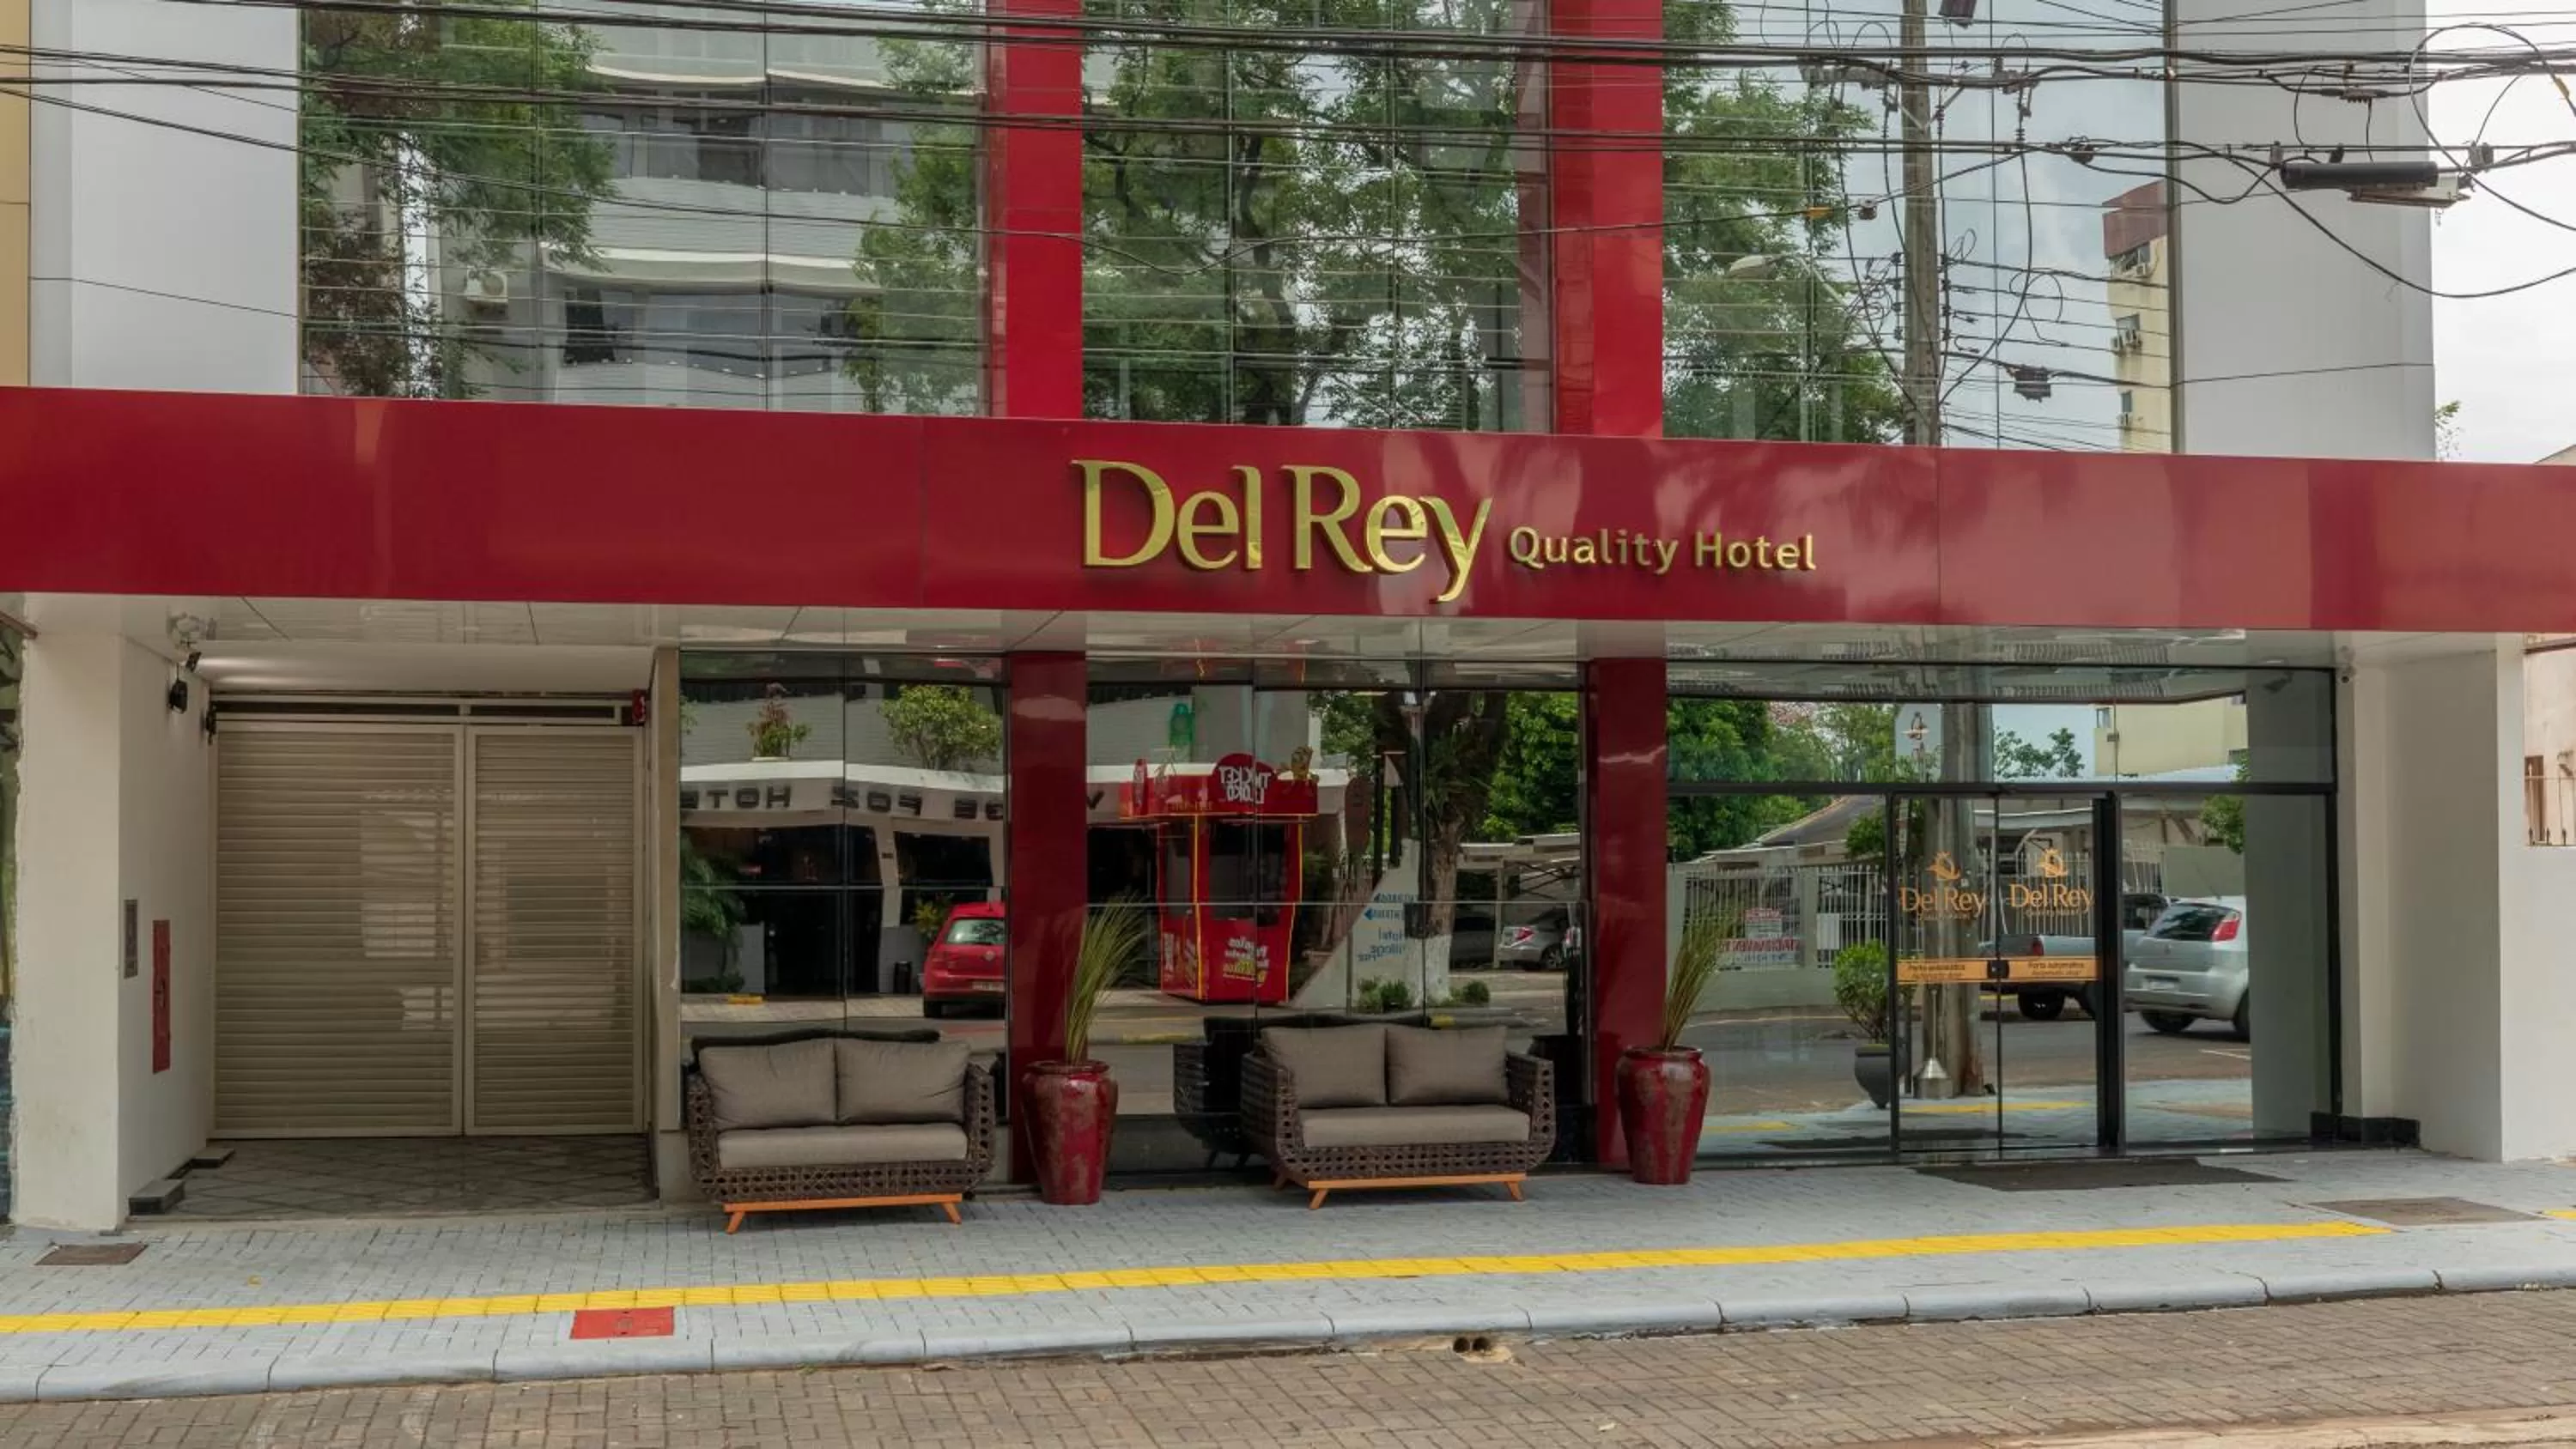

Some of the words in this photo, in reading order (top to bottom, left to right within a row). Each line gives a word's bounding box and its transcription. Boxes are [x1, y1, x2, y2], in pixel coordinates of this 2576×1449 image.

[1070, 459, 1262, 571] Del
[1280, 464, 1494, 603] Rey
[1510, 526, 1679, 574] Quality
[1694, 530, 1818, 571] Hotel
[1898, 886, 1938, 912] Del
[1943, 886, 1986, 918] Rey
[2009, 883, 2048, 907] Del
[2050, 883, 2095, 914] Rey
